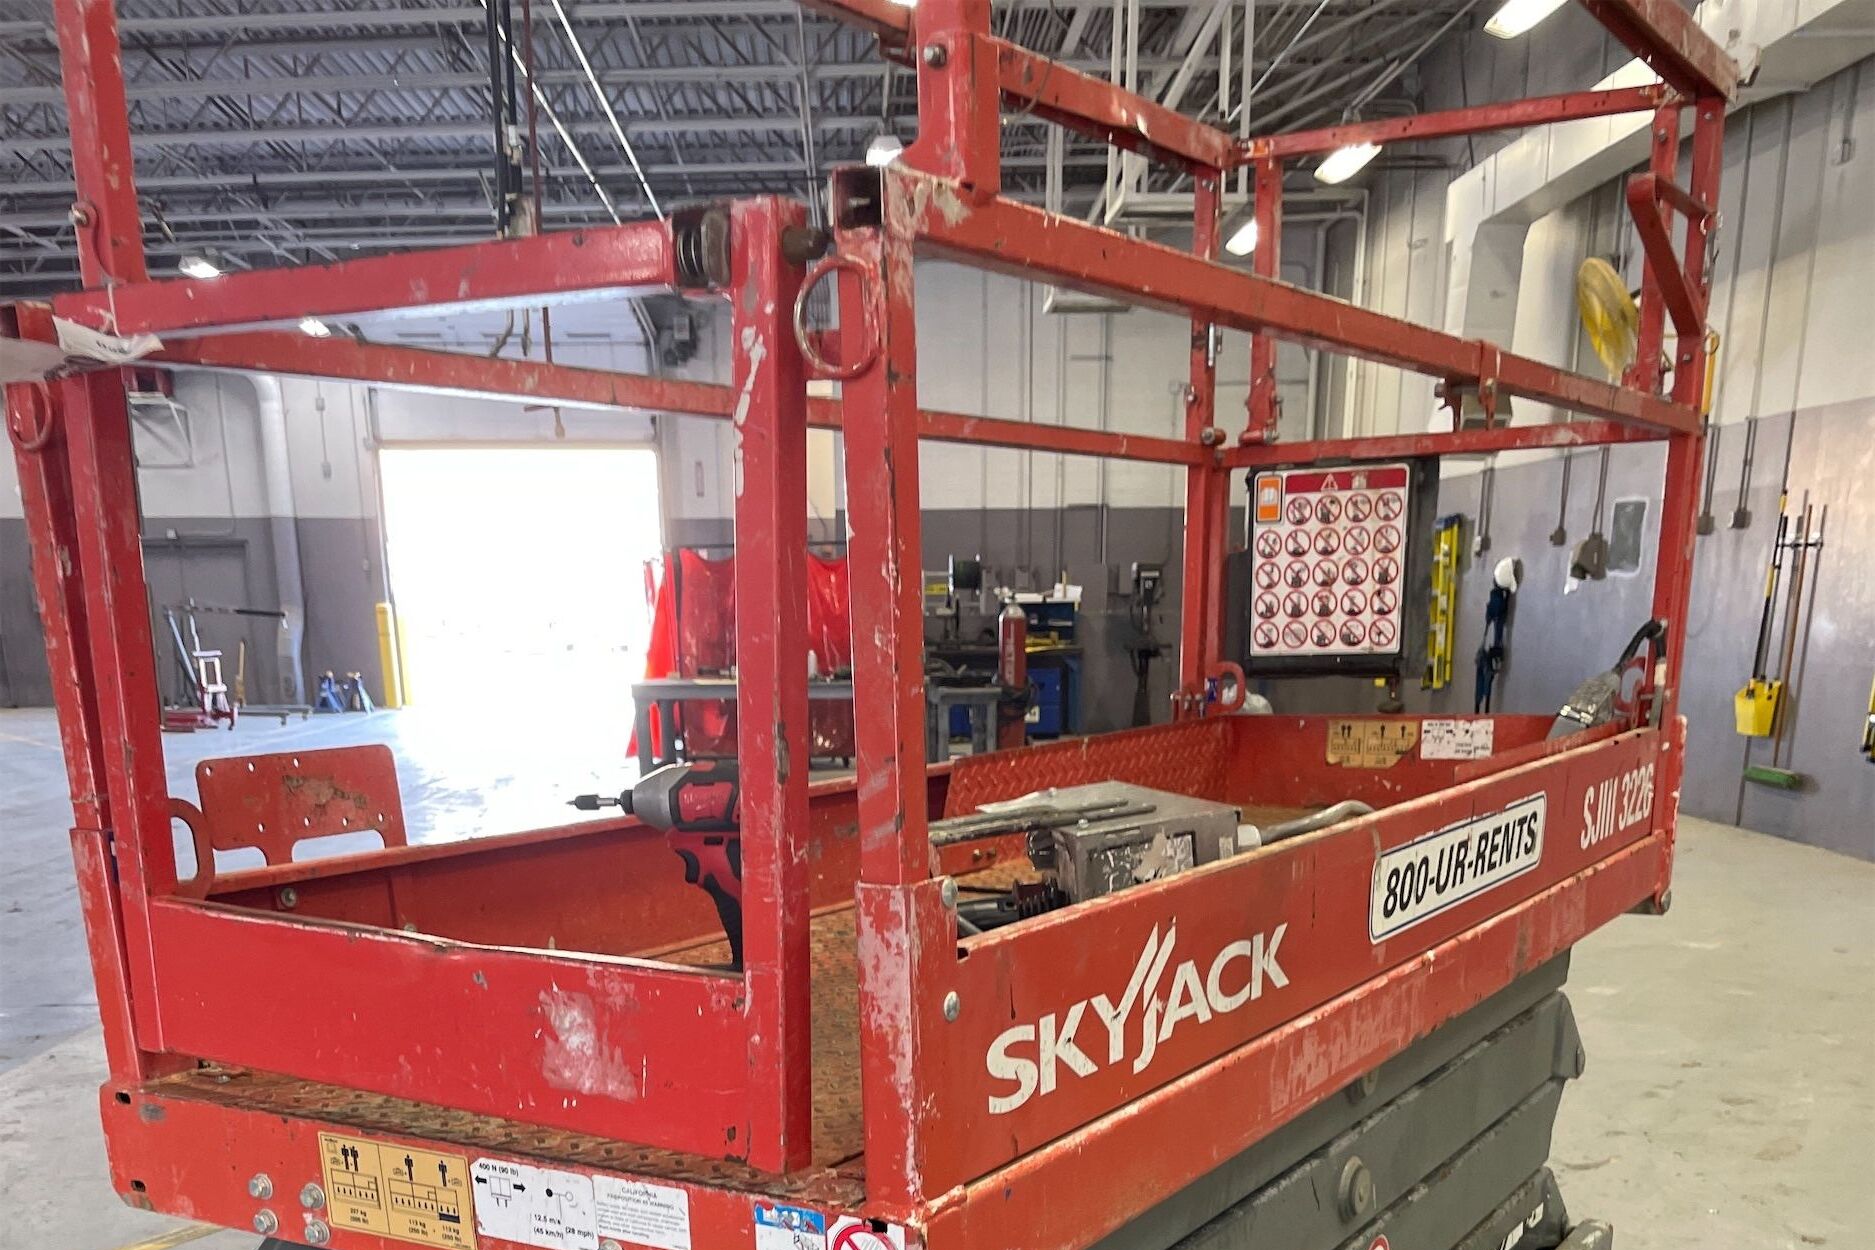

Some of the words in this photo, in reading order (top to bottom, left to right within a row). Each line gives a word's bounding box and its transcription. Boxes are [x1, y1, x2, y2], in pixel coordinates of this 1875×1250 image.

[1619, 763, 1654, 832] 3226
[1383, 811, 1538, 919] 800-UR-RENTS
[986, 916, 1290, 1115] SKYJACK
